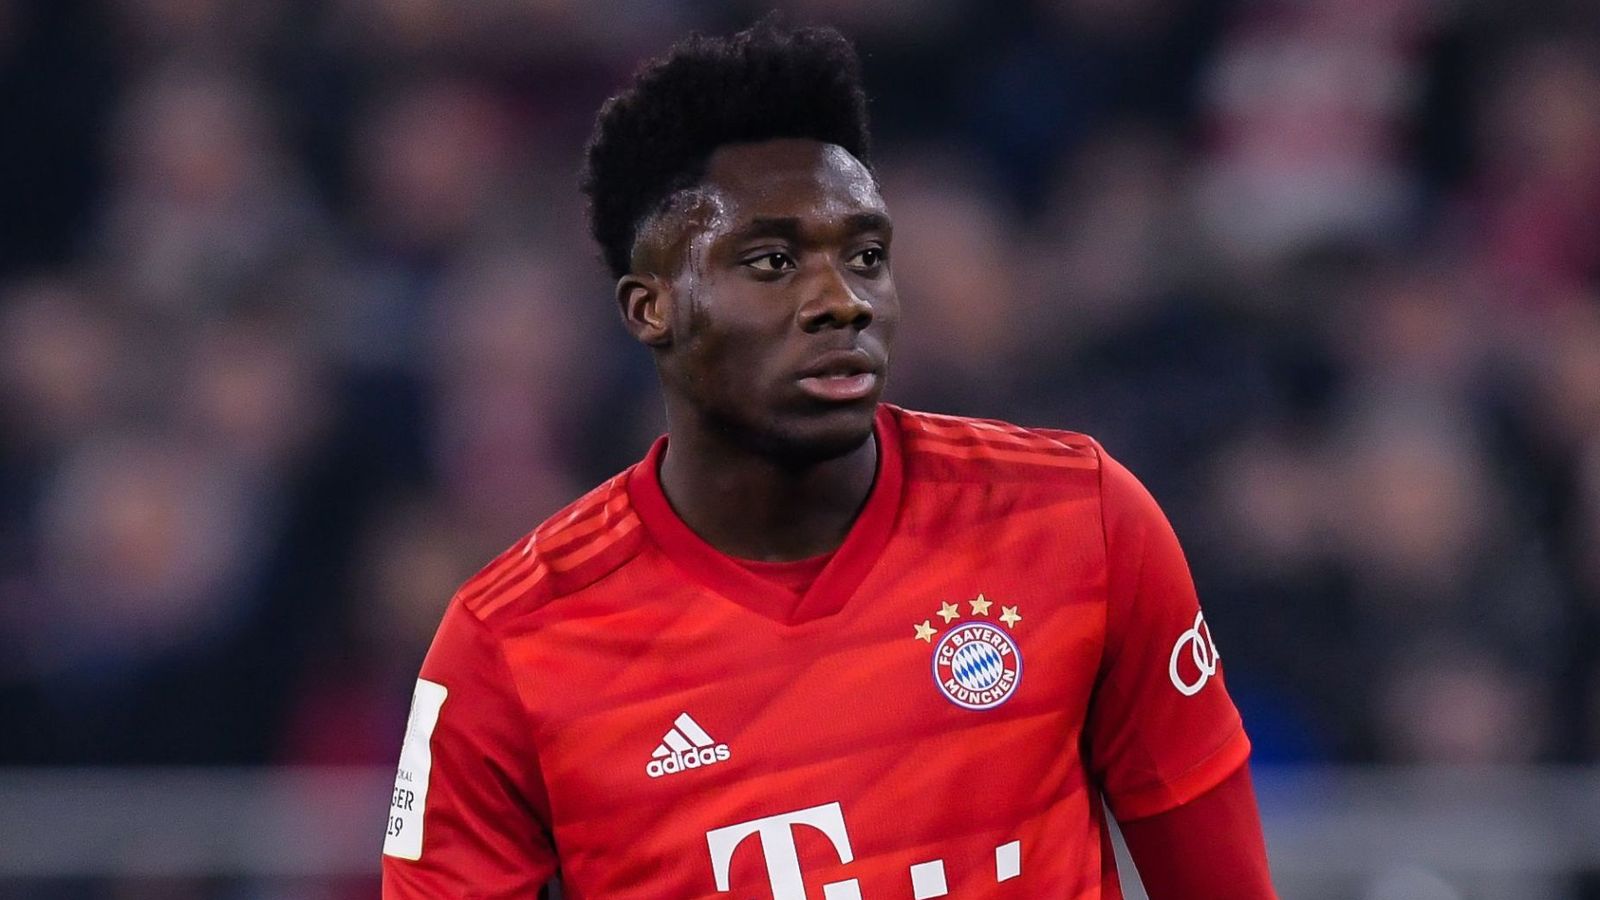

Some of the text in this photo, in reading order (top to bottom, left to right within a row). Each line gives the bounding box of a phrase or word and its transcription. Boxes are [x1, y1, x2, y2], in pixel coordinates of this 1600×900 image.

[939, 628, 1011, 666] FC BAYERN
[646, 744, 731, 778] adidas
